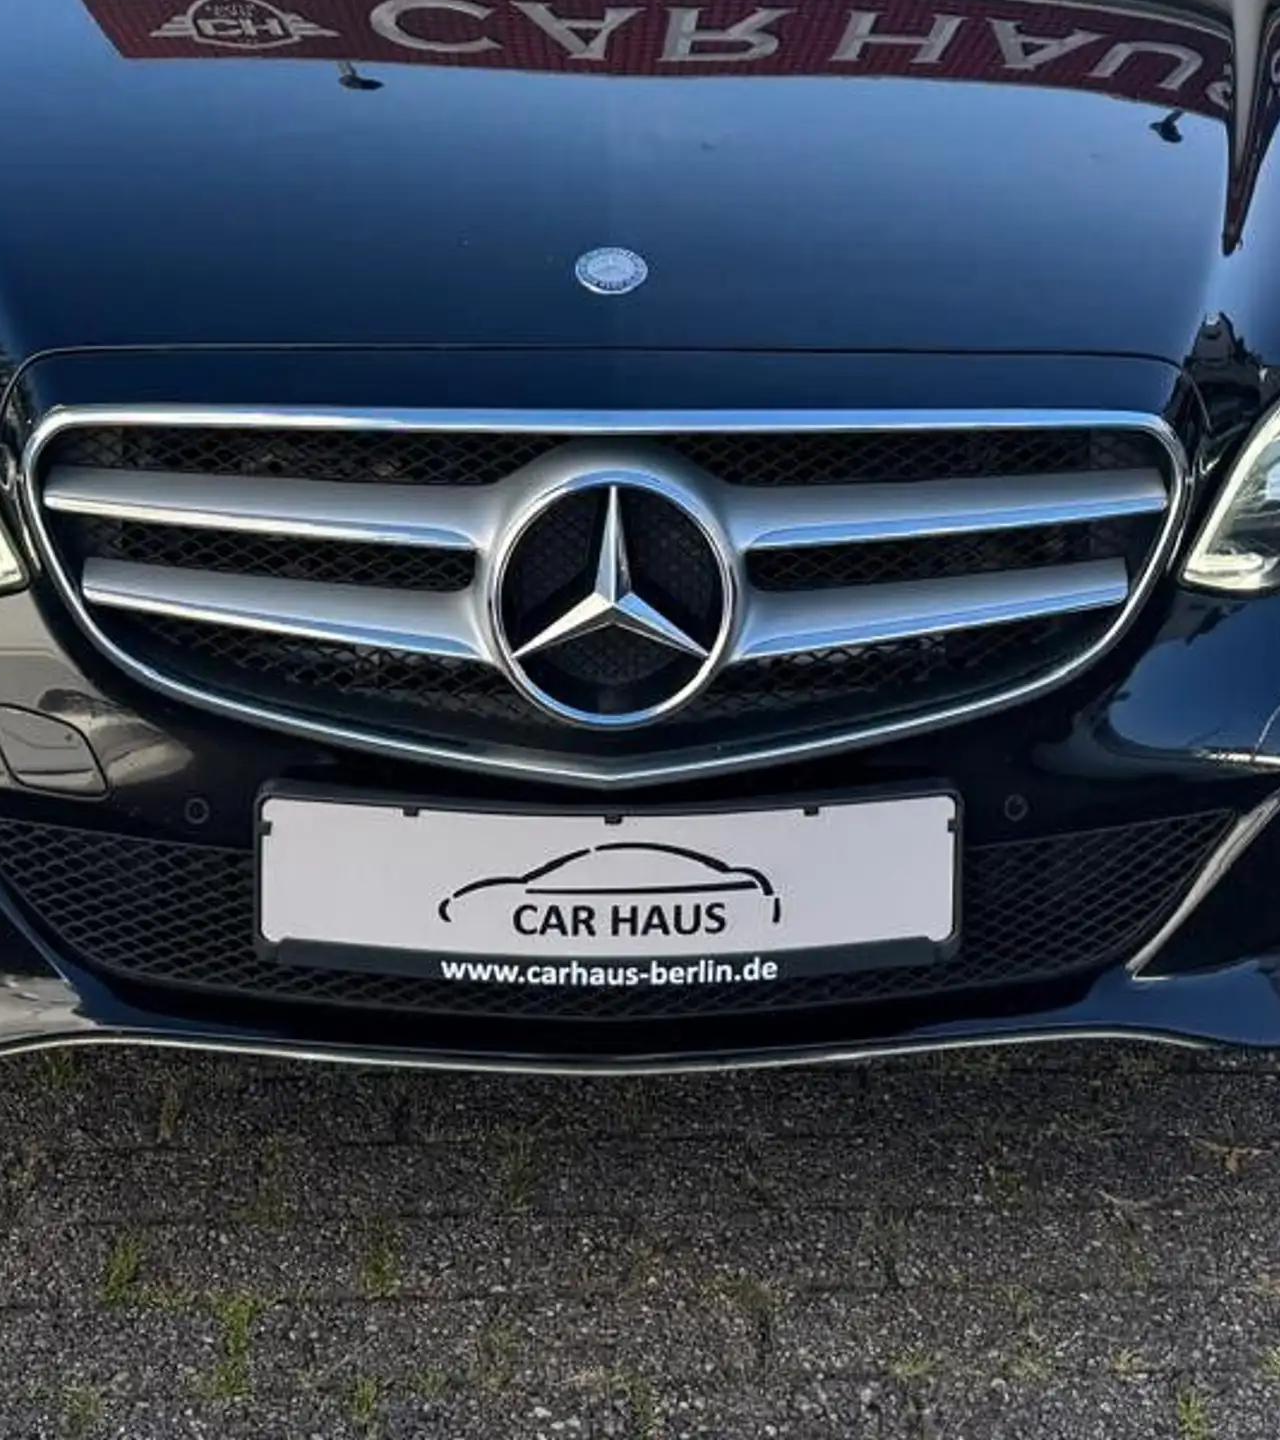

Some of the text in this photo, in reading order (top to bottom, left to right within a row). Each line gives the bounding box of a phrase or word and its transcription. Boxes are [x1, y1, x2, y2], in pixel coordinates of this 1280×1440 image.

[512, 903, 727, 937] CAR HAUS
[441, 956, 779, 986] www.carhaus-berlin.de
